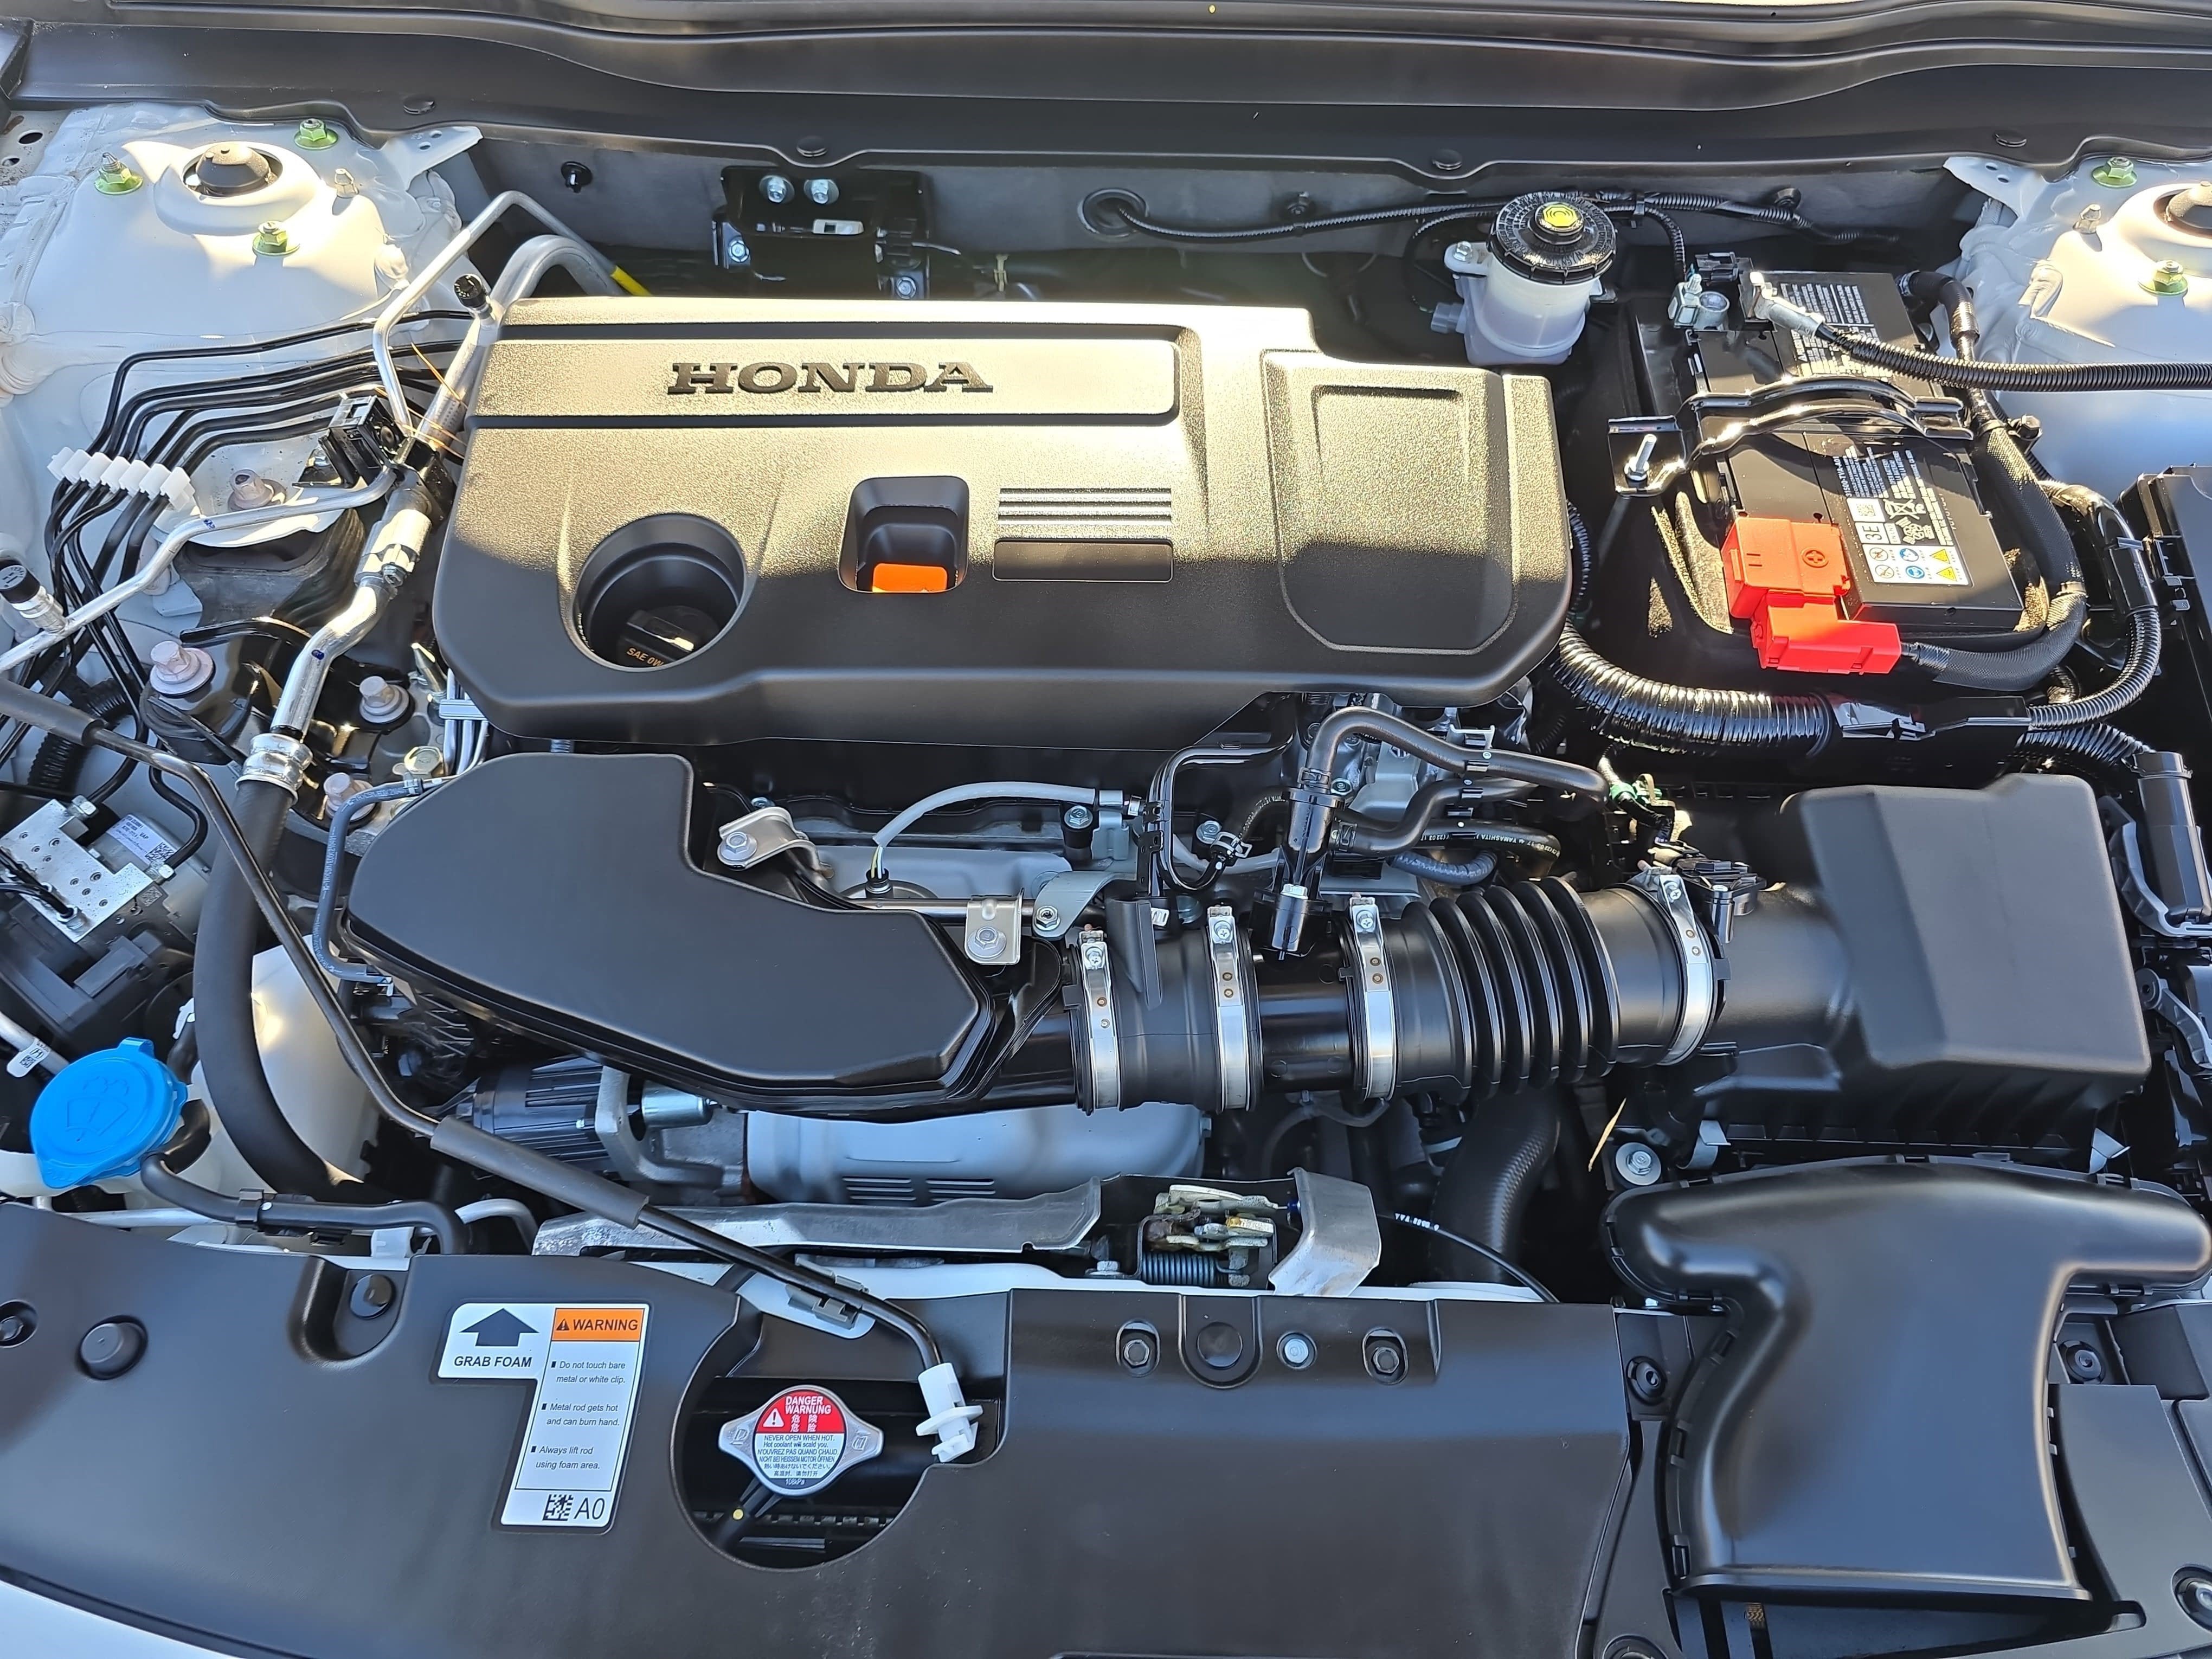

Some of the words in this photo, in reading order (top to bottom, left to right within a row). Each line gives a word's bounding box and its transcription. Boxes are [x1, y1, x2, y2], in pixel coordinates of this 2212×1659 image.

[667, 362, 994, 395] HONDA
[1862, 526, 1882, 540] 3E
[626, 648, 648, 661] SAE
[1481, 834, 1517, 844] YAMASHITA
[573, 1319, 638, 1331] WARNING
[454, 1356, 491, 1367] GRAB
[494, 1356, 532, 1367] FOAM
[610, 1376, 626, 1385] clip.
[785, 1396, 824, 1405] DANGER
[587, 1405, 604, 1413] gets
[785, 1405, 831, 1414] WARNUNG
[539, 1446, 568, 1456] Always
[536, 1461, 557, 1470] using
[574, 1498, 605, 1519] A0
